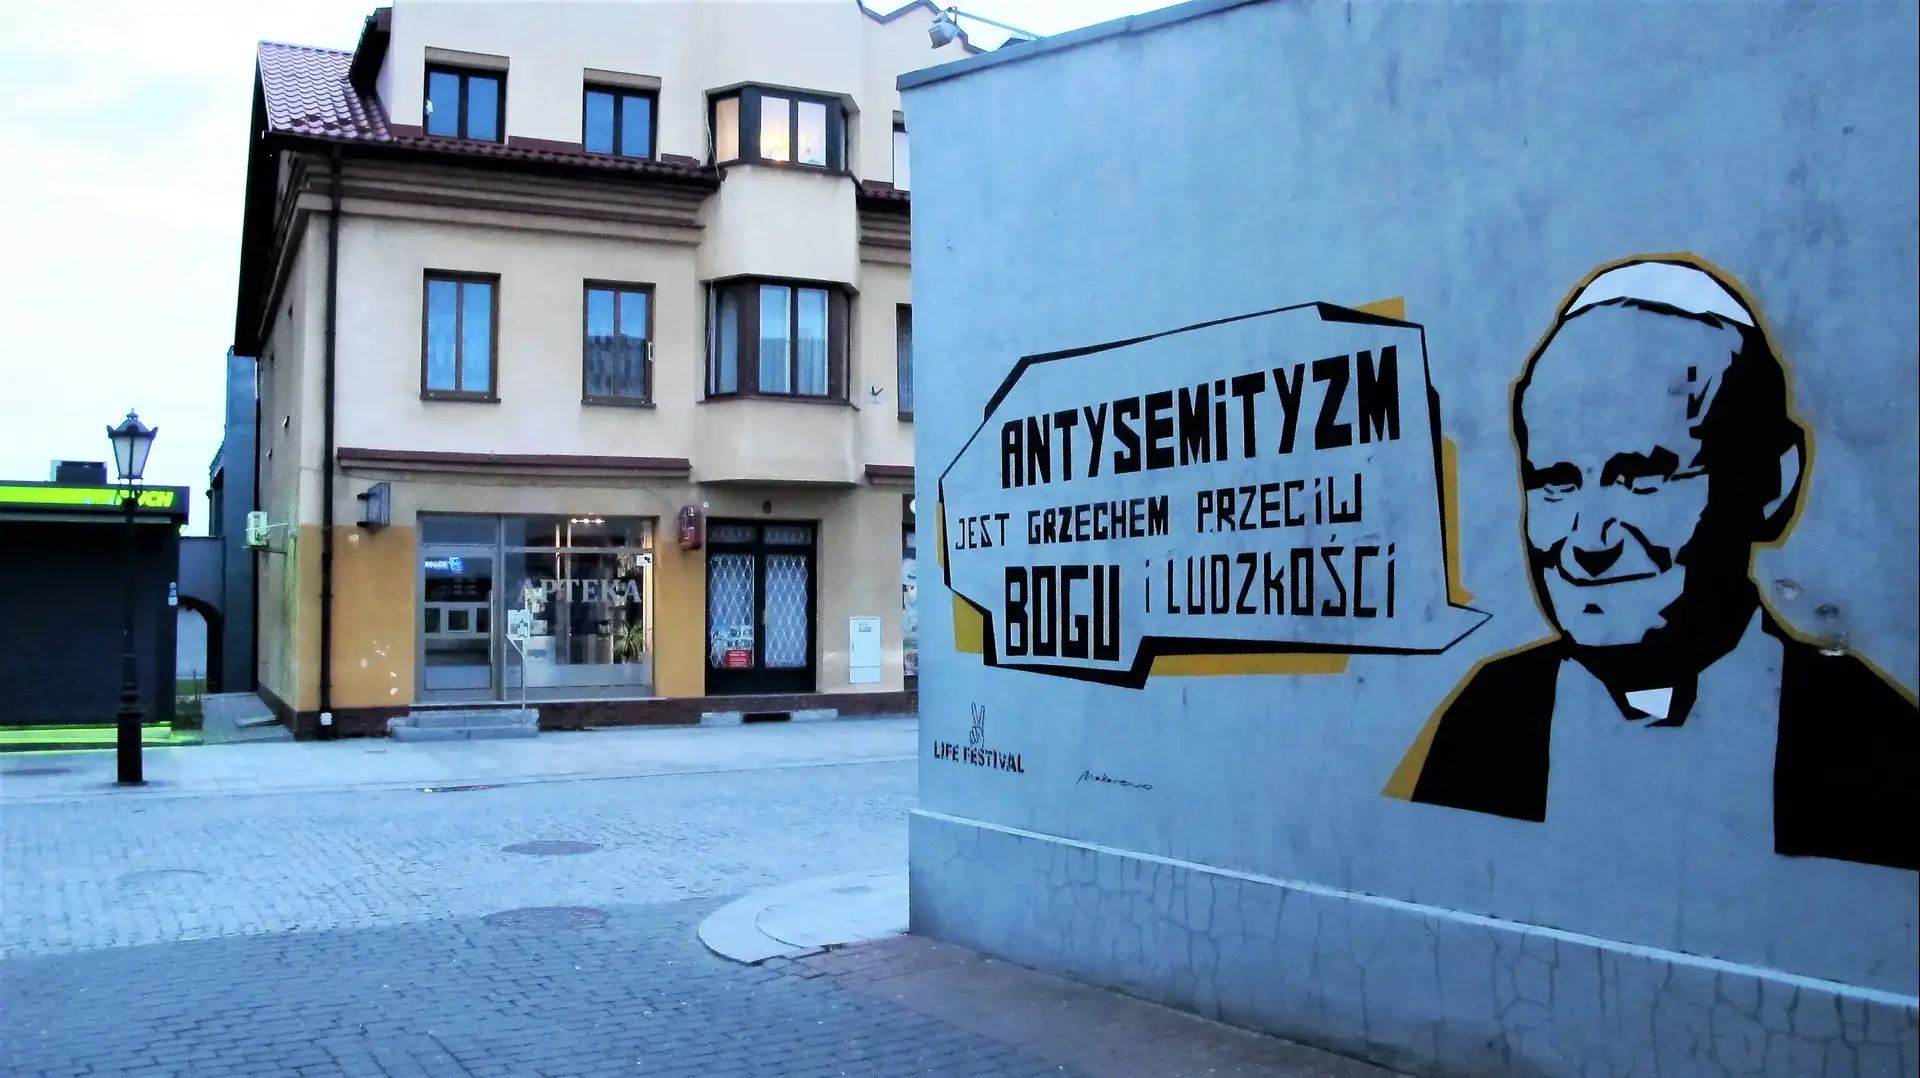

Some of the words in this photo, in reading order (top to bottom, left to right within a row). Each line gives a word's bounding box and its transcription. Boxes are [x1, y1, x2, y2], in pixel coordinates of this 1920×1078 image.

[955, 513, 1009, 550] JEST
[1028, 494, 1169, 545] GRZECHEM
[517, 579, 642, 603] APTEKA
[1005, 565, 1119, 661] BOGU
[934, 740, 959, 762] LIFE
[963, 746, 1025, 774] FESTIVAL
